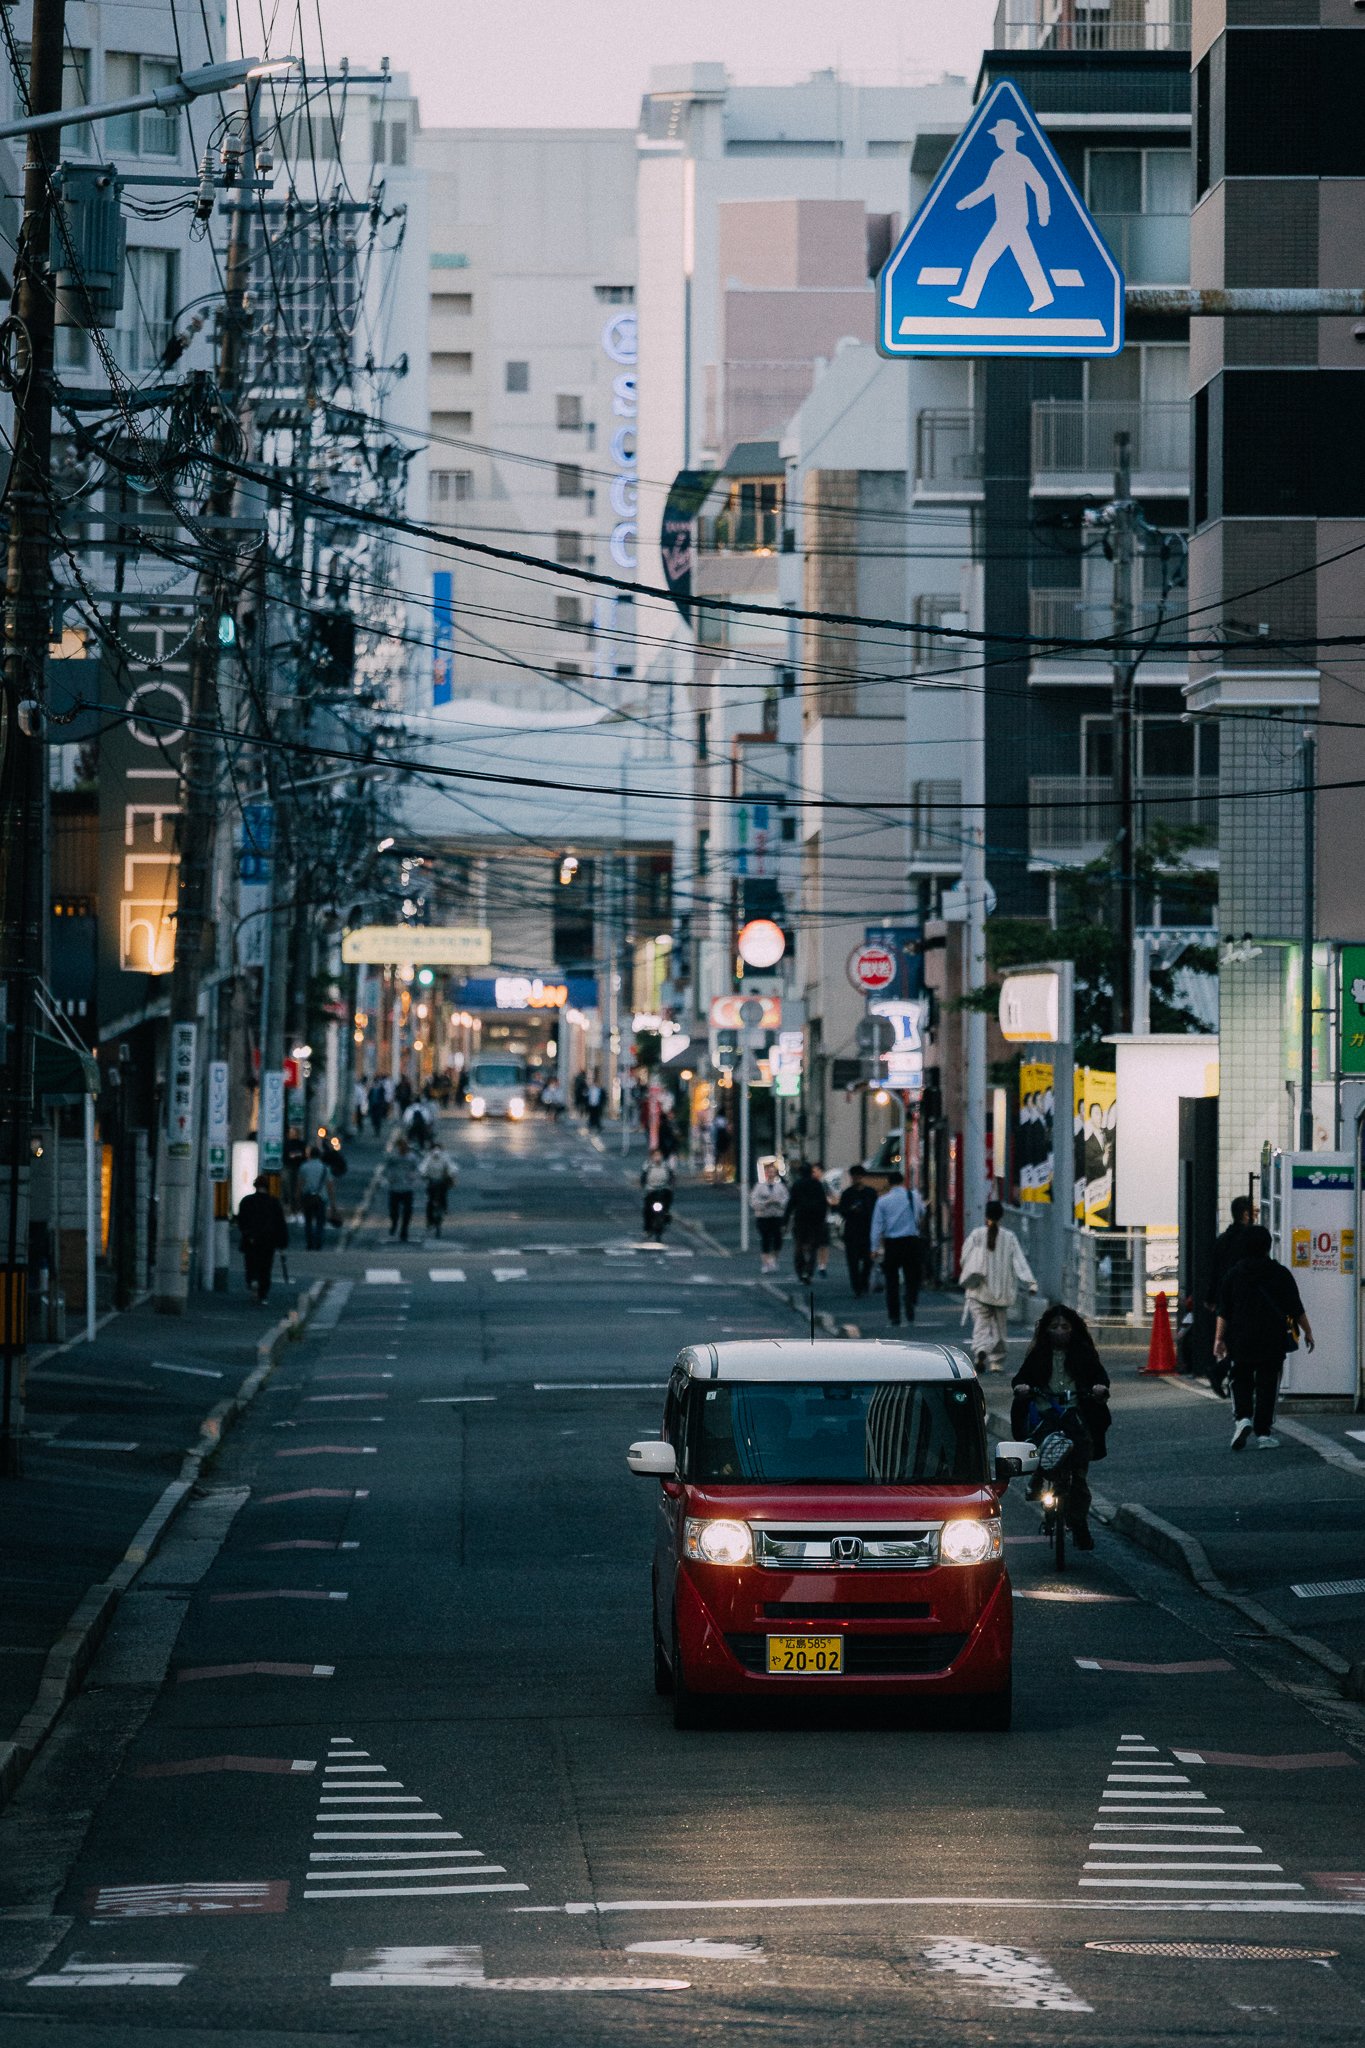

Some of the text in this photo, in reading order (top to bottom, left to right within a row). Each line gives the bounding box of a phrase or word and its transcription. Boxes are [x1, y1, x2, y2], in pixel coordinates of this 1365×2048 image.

[785, 1639, 827, 1649] 広島 585
[771, 1651, 839, 1670] や 20-02
